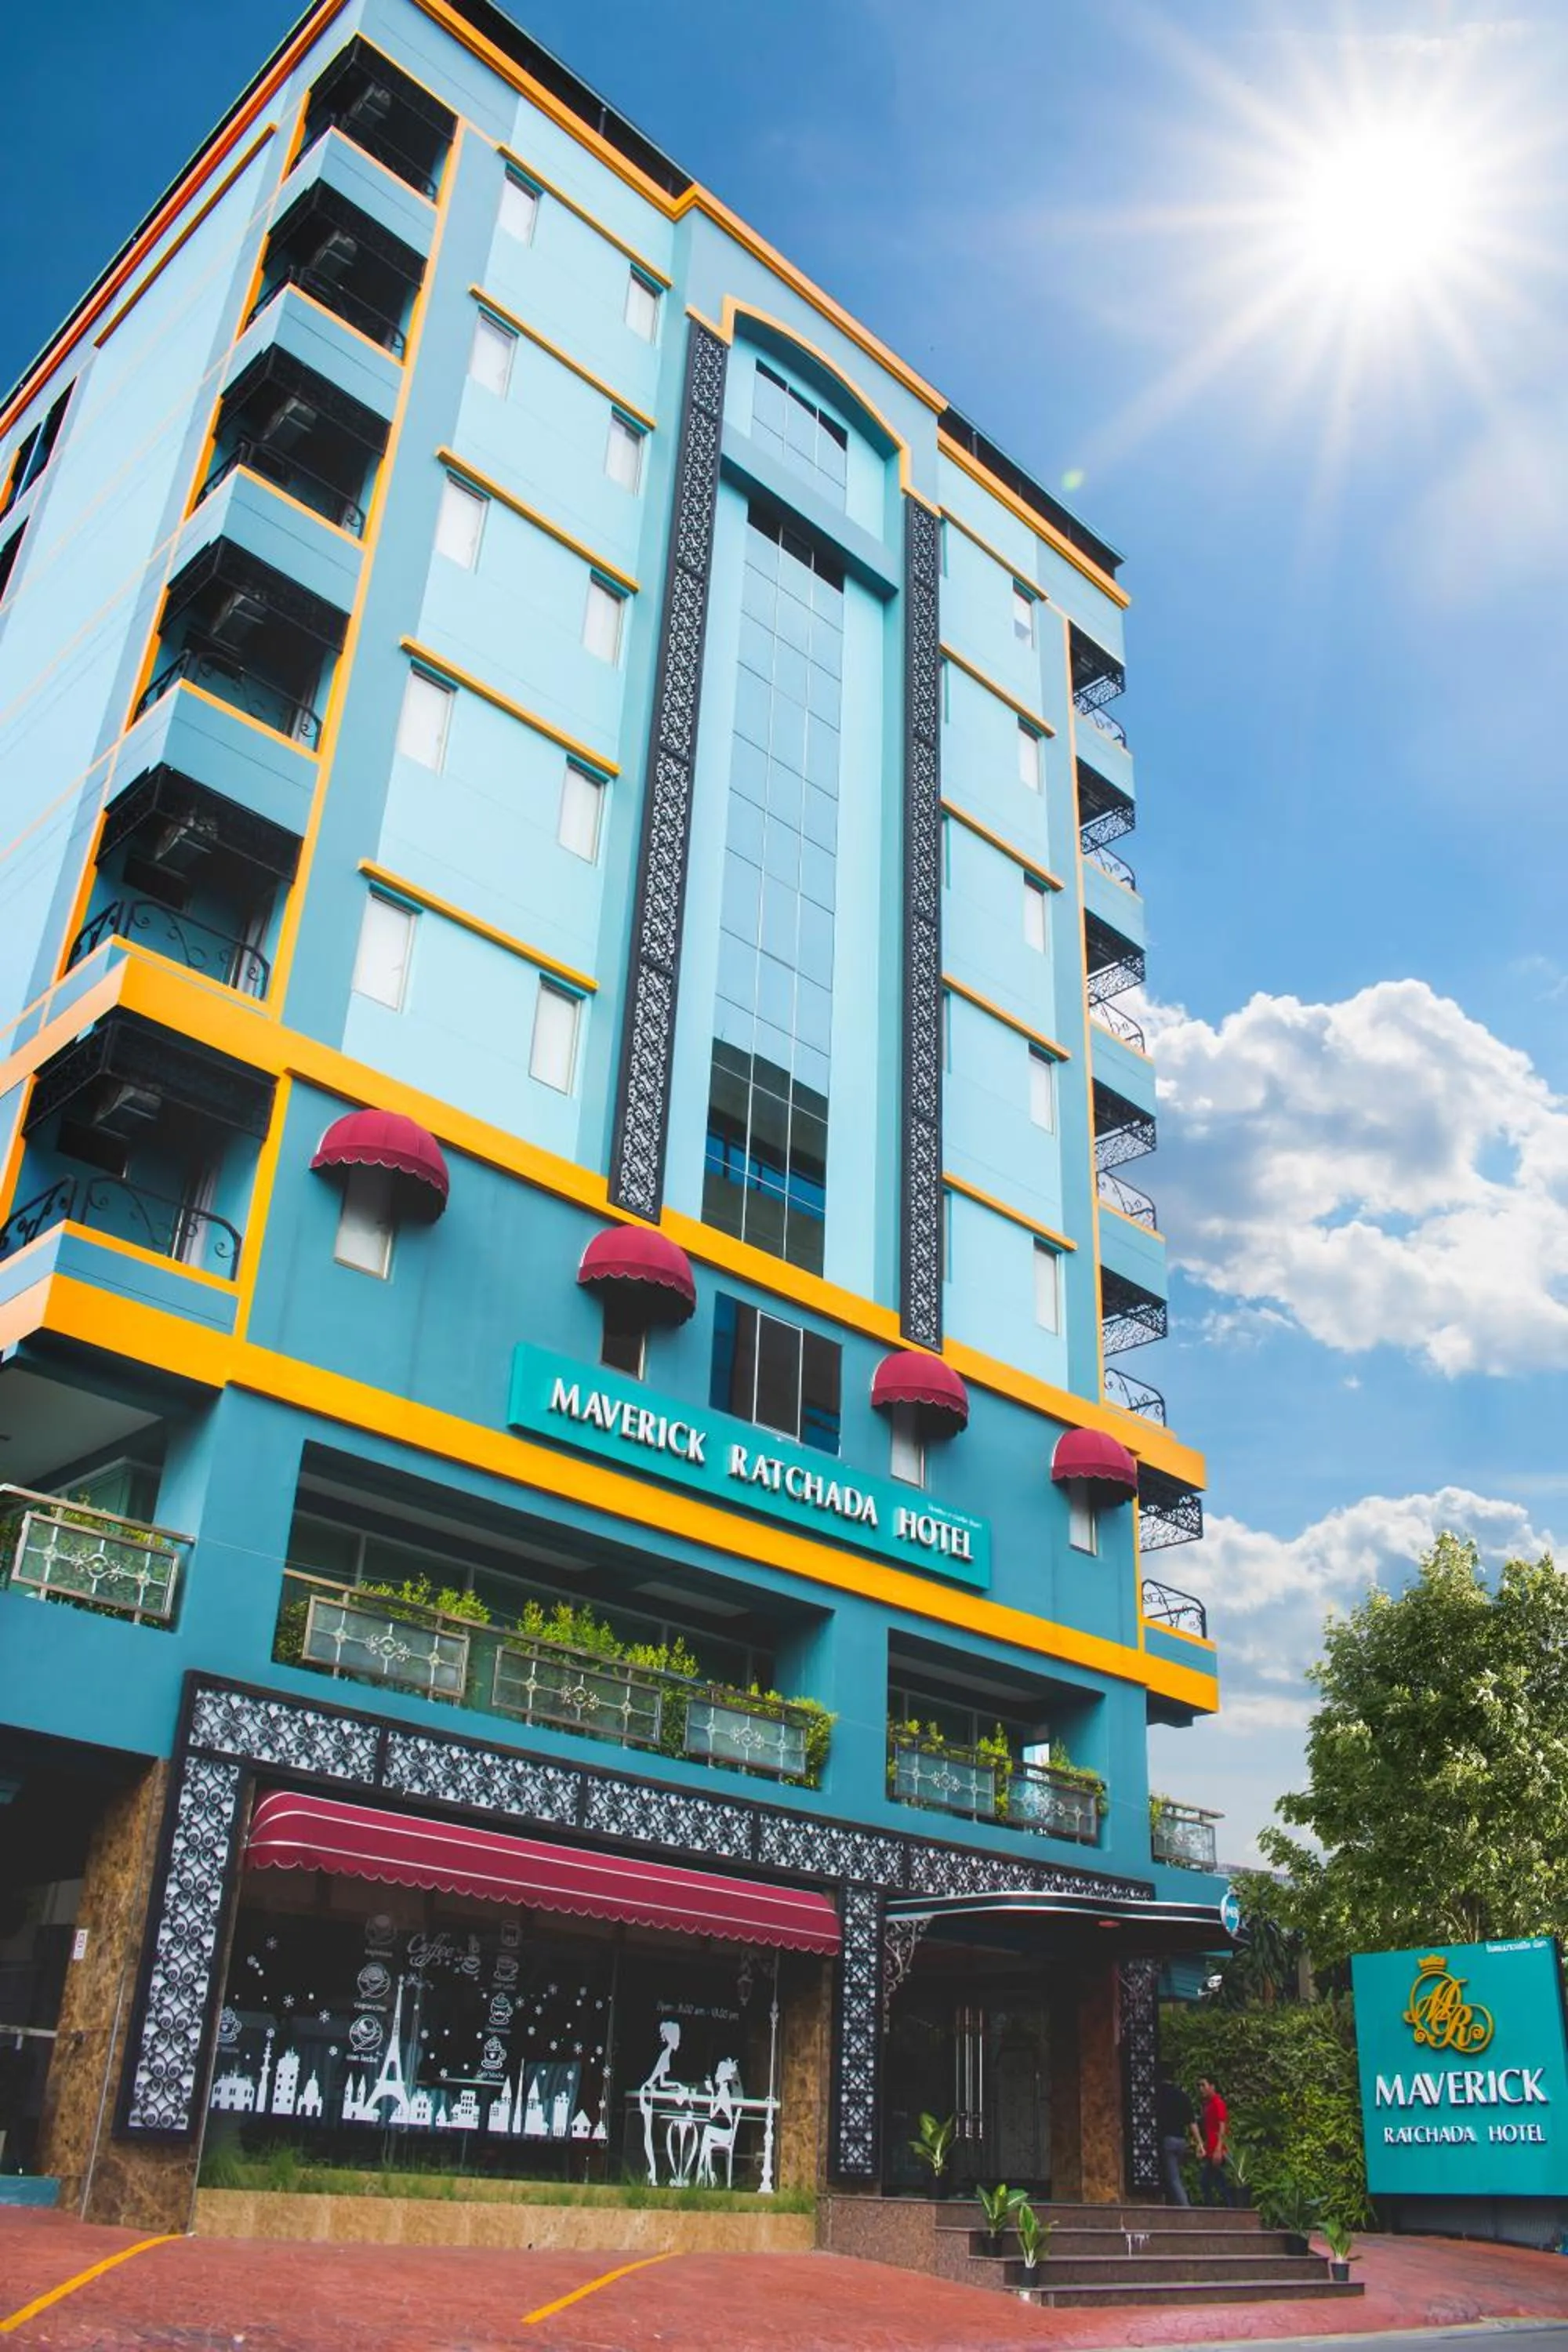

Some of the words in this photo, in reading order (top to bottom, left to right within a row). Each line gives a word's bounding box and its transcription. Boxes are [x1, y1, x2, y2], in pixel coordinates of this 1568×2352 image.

[550, 1377, 707, 1464] MAVERICK
[729, 1444, 879, 1528] RATCHADA
[895, 1506, 975, 1561] HOTEL
[1375, 2067, 1549, 2107] MAVERICK
[1384, 2125, 1475, 2144] RATCHADA
[1489, 2124, 1545, 2143] HOTEL
